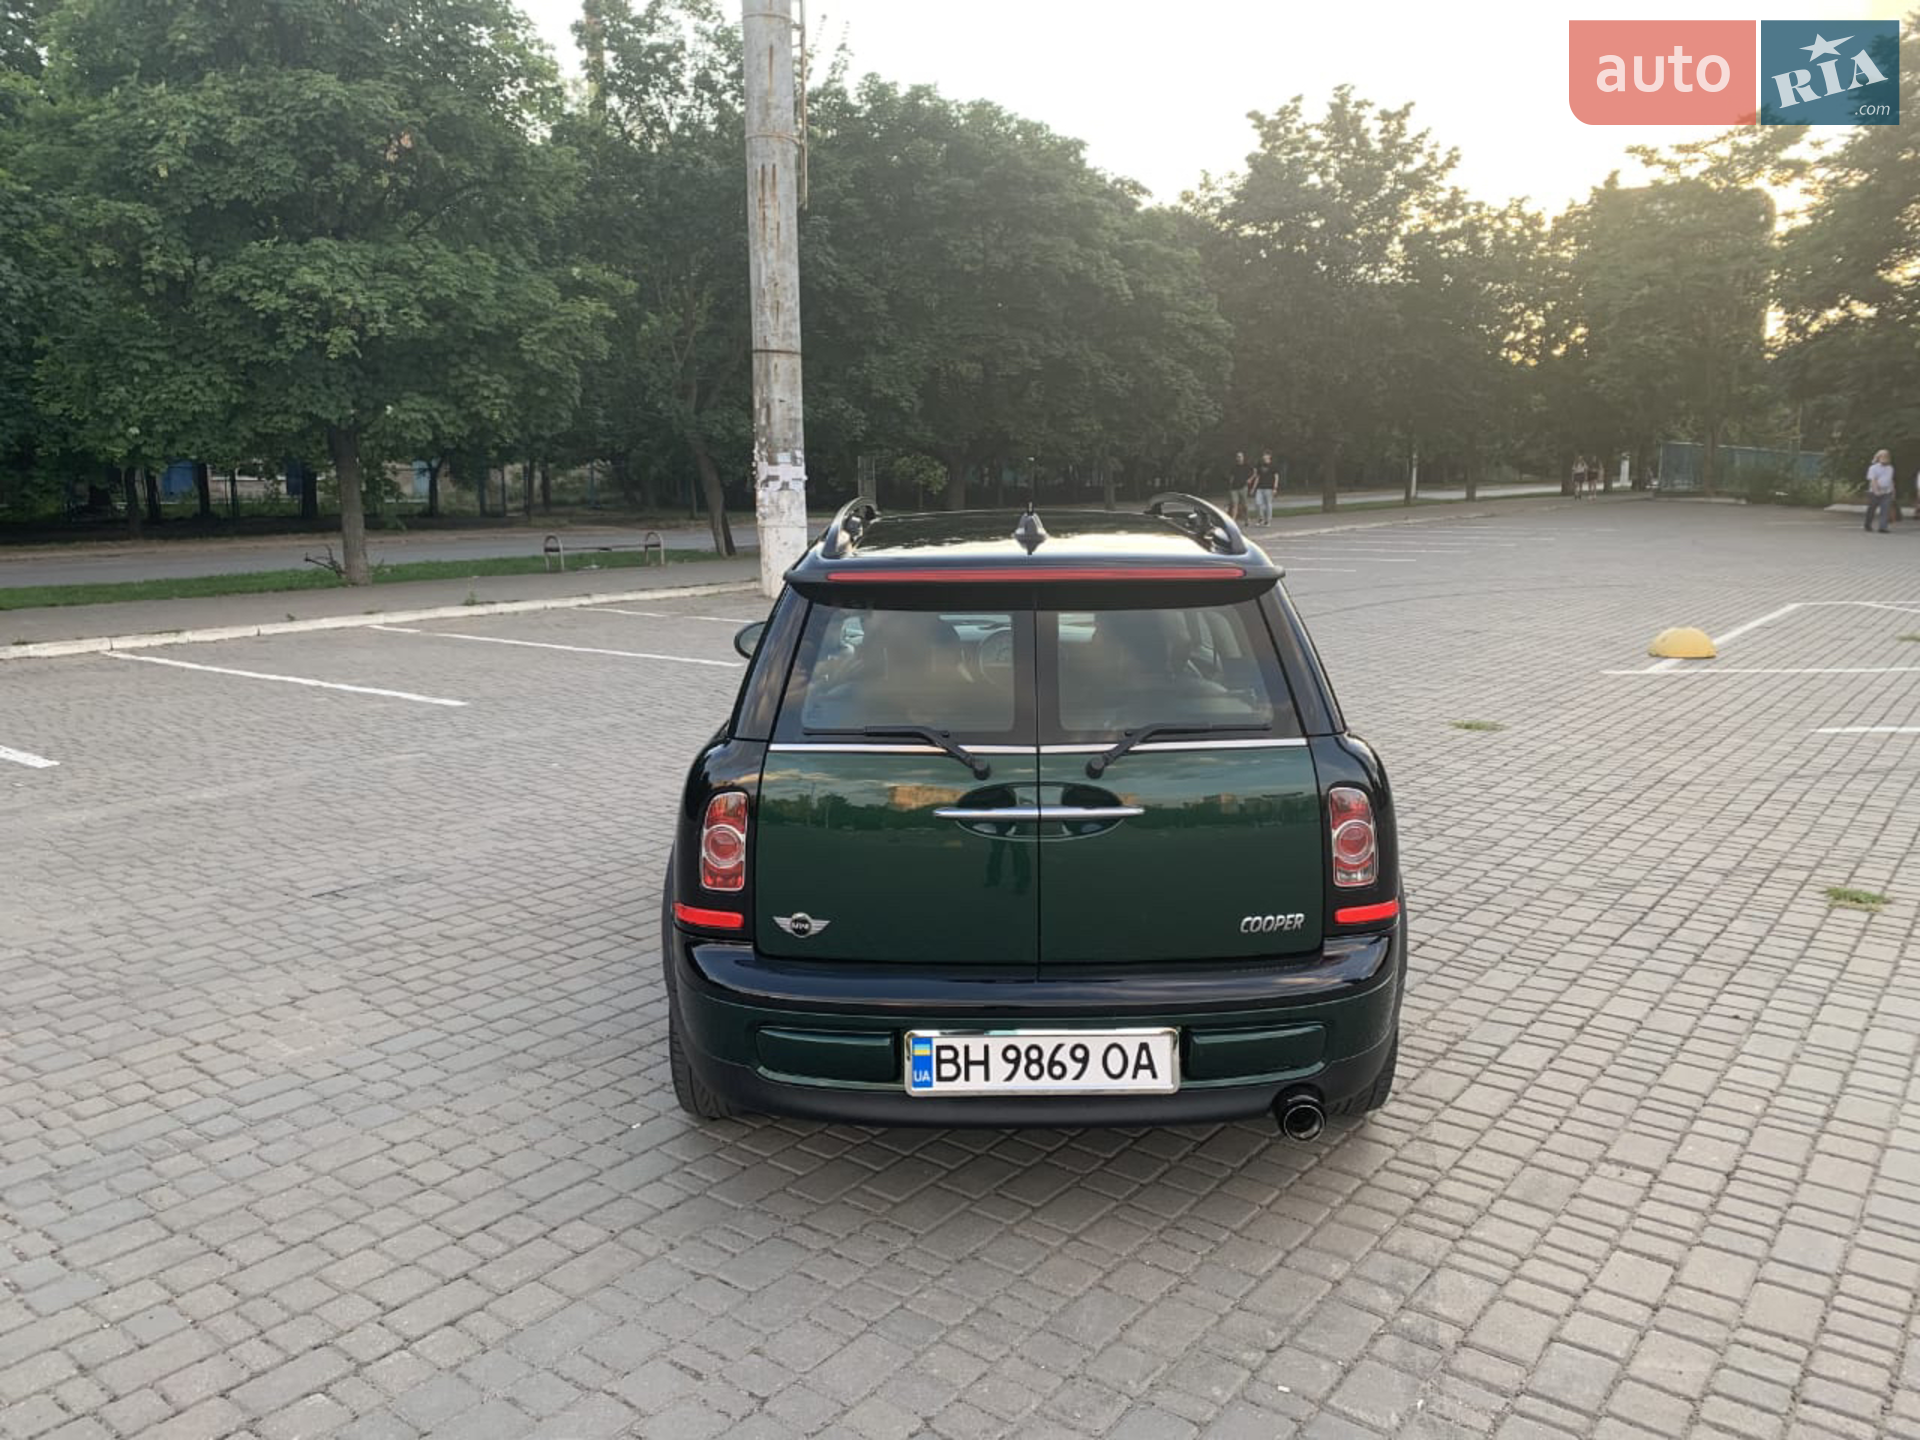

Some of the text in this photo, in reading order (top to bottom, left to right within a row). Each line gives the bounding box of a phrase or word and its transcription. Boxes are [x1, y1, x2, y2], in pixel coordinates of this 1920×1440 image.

[1240, 913, 1304, 932] COOPER
[935, 1042, 1158, 1082] BH 9869 OA
[914, 1071, 931, 1082] UA
